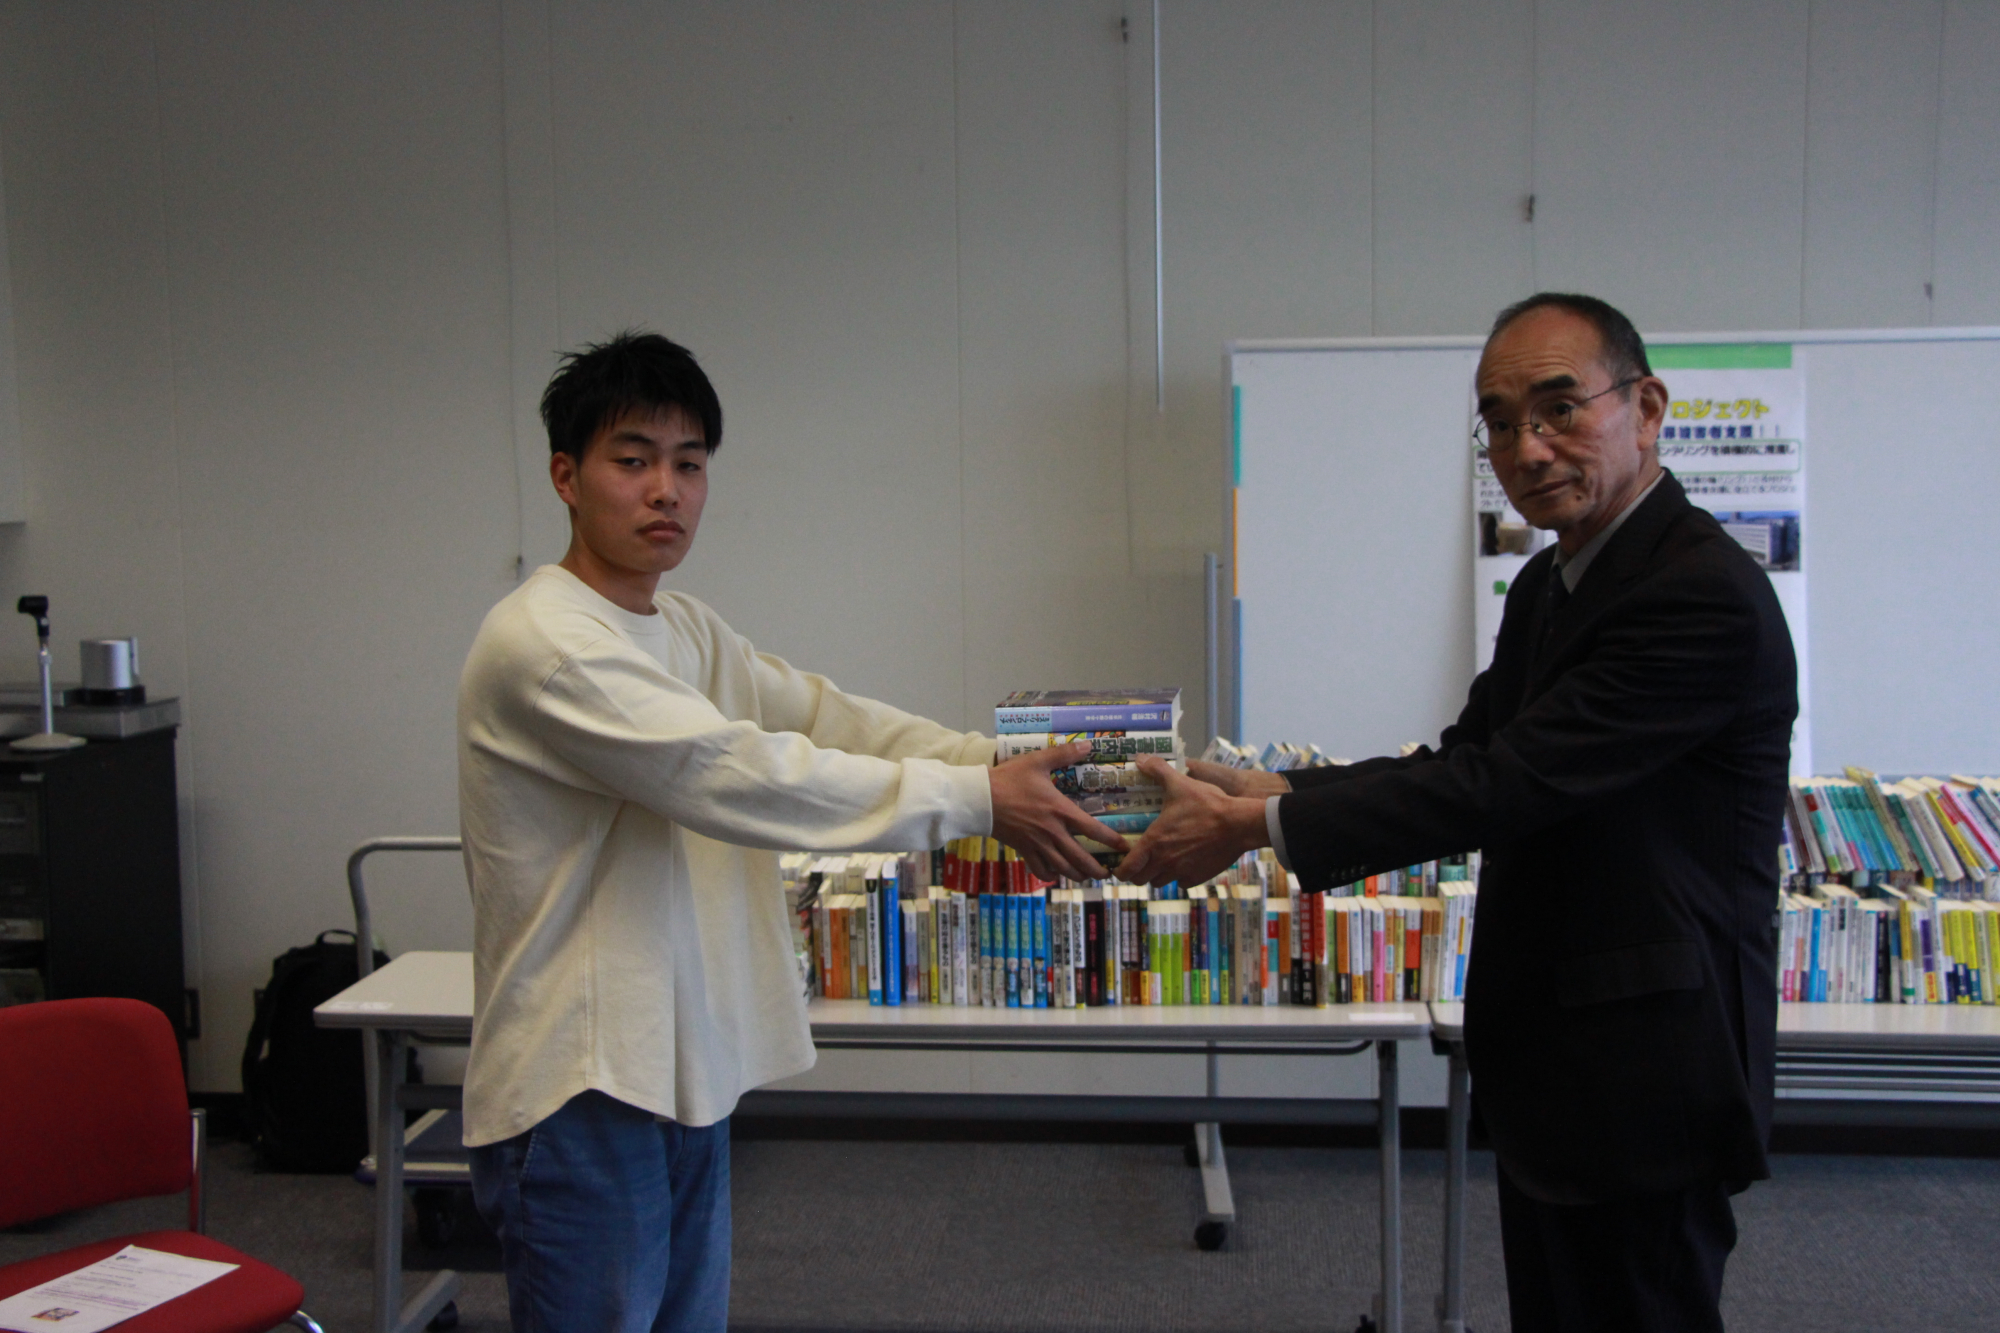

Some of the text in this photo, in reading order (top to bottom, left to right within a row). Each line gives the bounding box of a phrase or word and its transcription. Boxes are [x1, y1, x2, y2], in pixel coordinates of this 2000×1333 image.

[1671, 399, 1769, 419] ロジェクト
